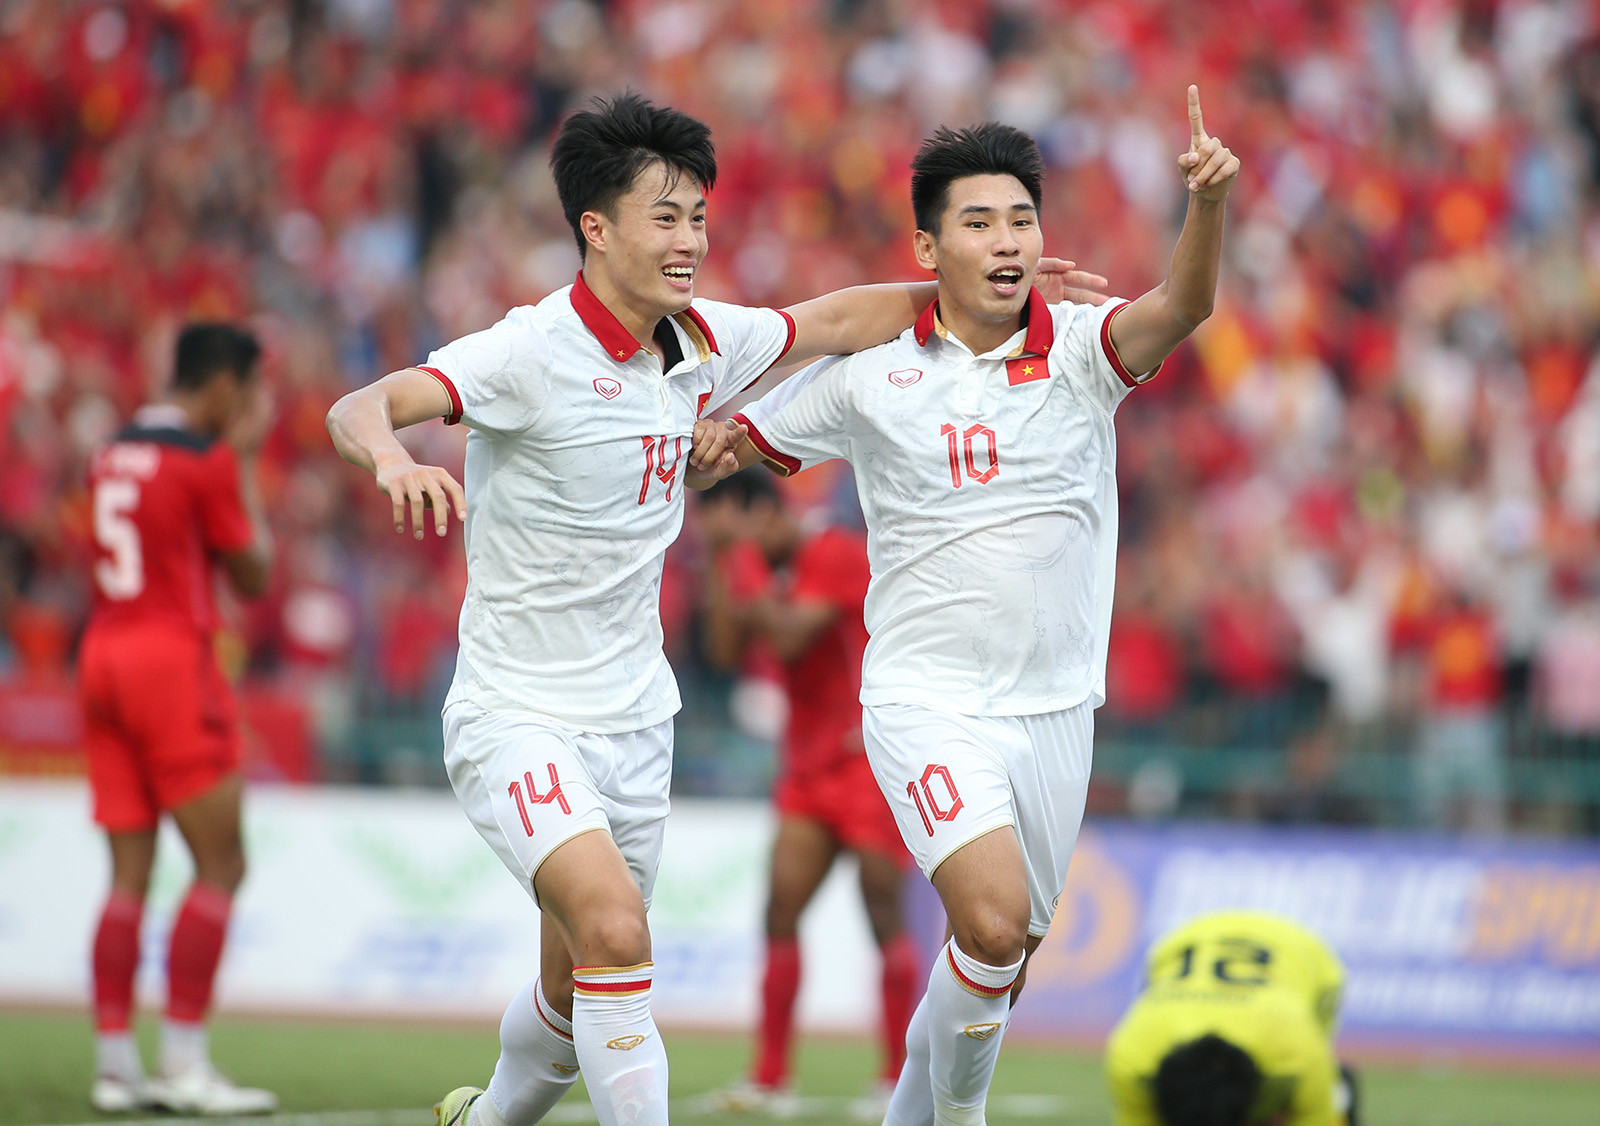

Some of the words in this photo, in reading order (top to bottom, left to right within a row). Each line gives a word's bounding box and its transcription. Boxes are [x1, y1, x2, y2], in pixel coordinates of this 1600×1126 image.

[637, 434, 682, 506] 14
[940, 422, 1000, 490] 10
[94, 477, 145, 600] 5
[507, 762, 572, 837] 14
[906, 763, 965, 838] 10
